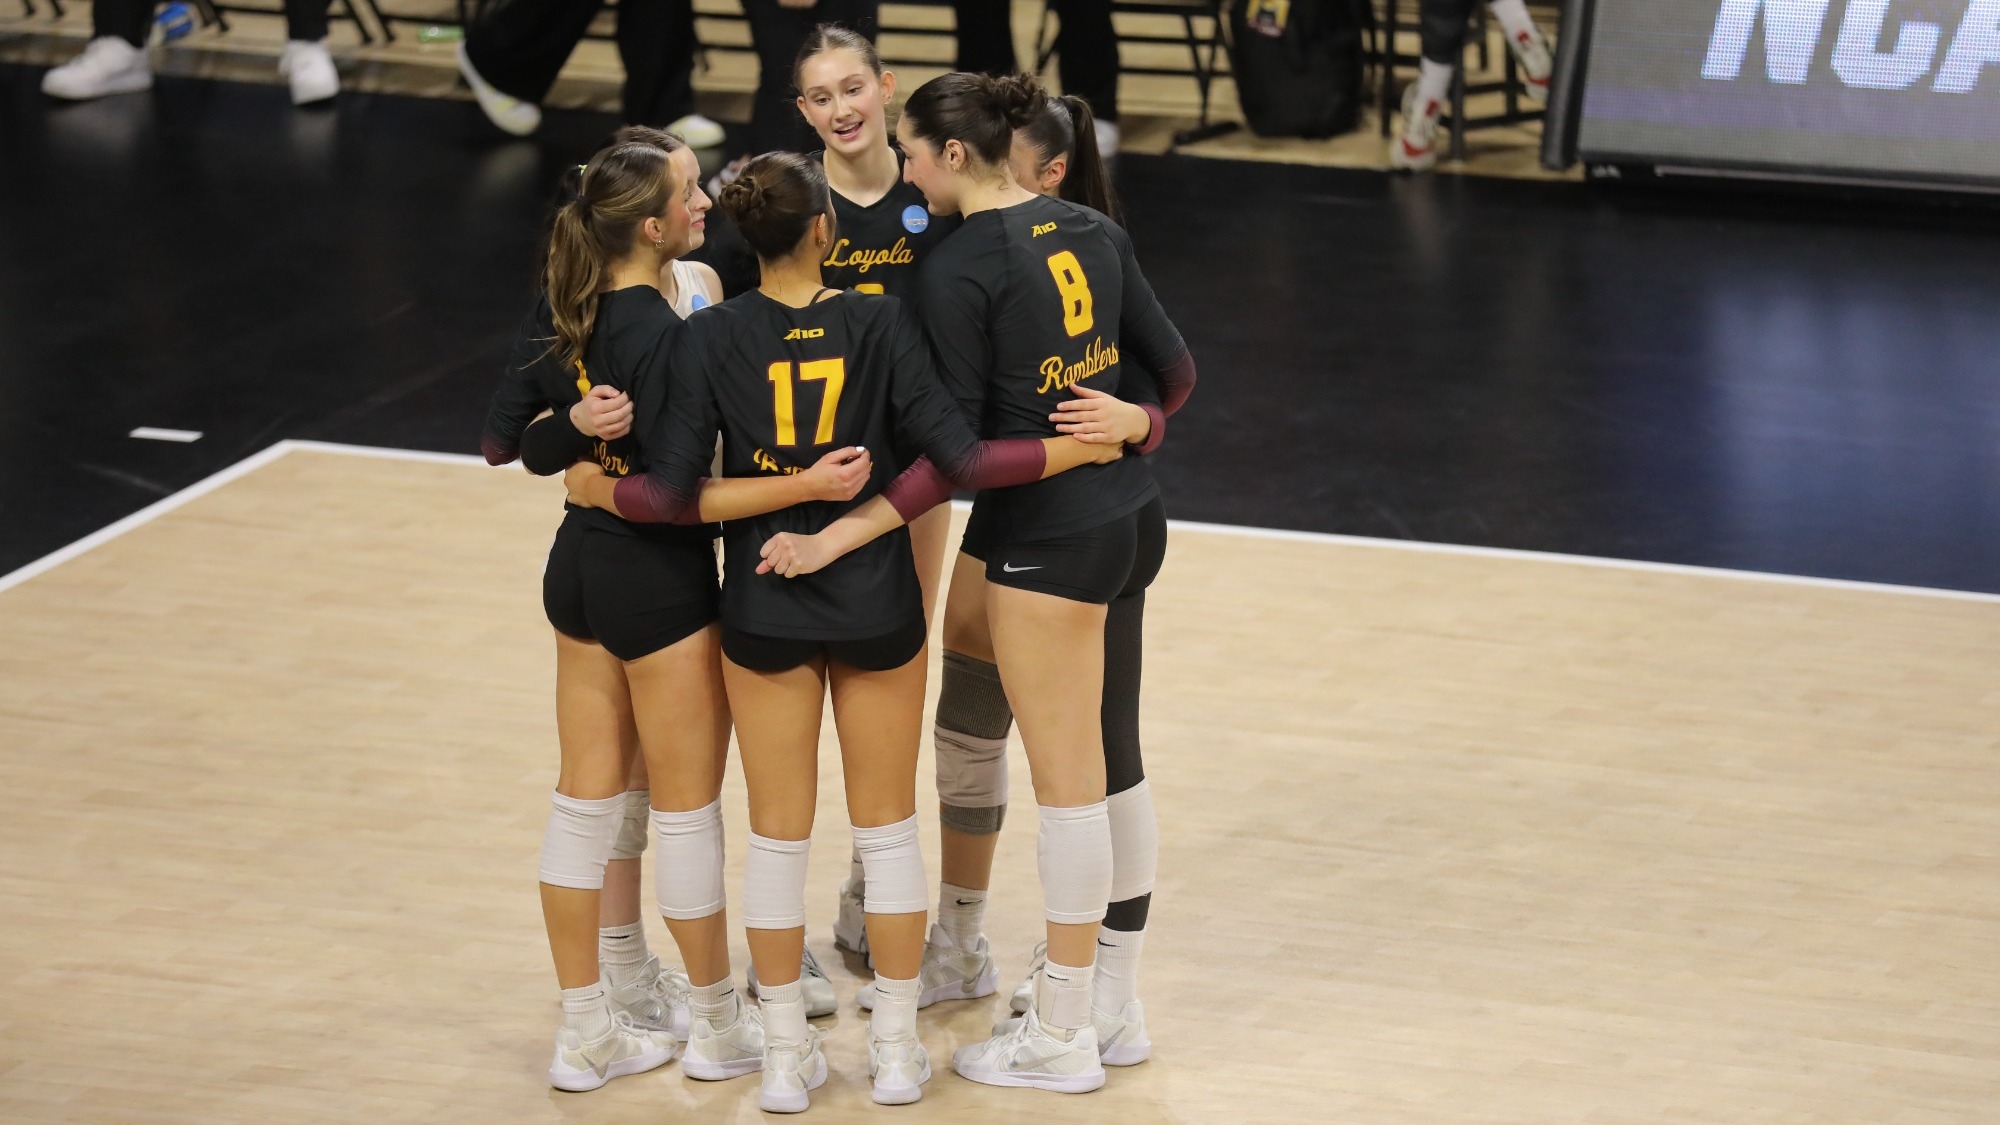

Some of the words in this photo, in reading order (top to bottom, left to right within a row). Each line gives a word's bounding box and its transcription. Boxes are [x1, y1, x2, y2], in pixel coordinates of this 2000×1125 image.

[1031, 221, 1057, 238] A10
[823, 236, 914, 273] Loyola
[1047, 250, 1094, 338] 8
[783, 328, 825, 341] A10
[1036, 336, 1119, 394] Ramblers
[768, 356, 845, 446] 17
